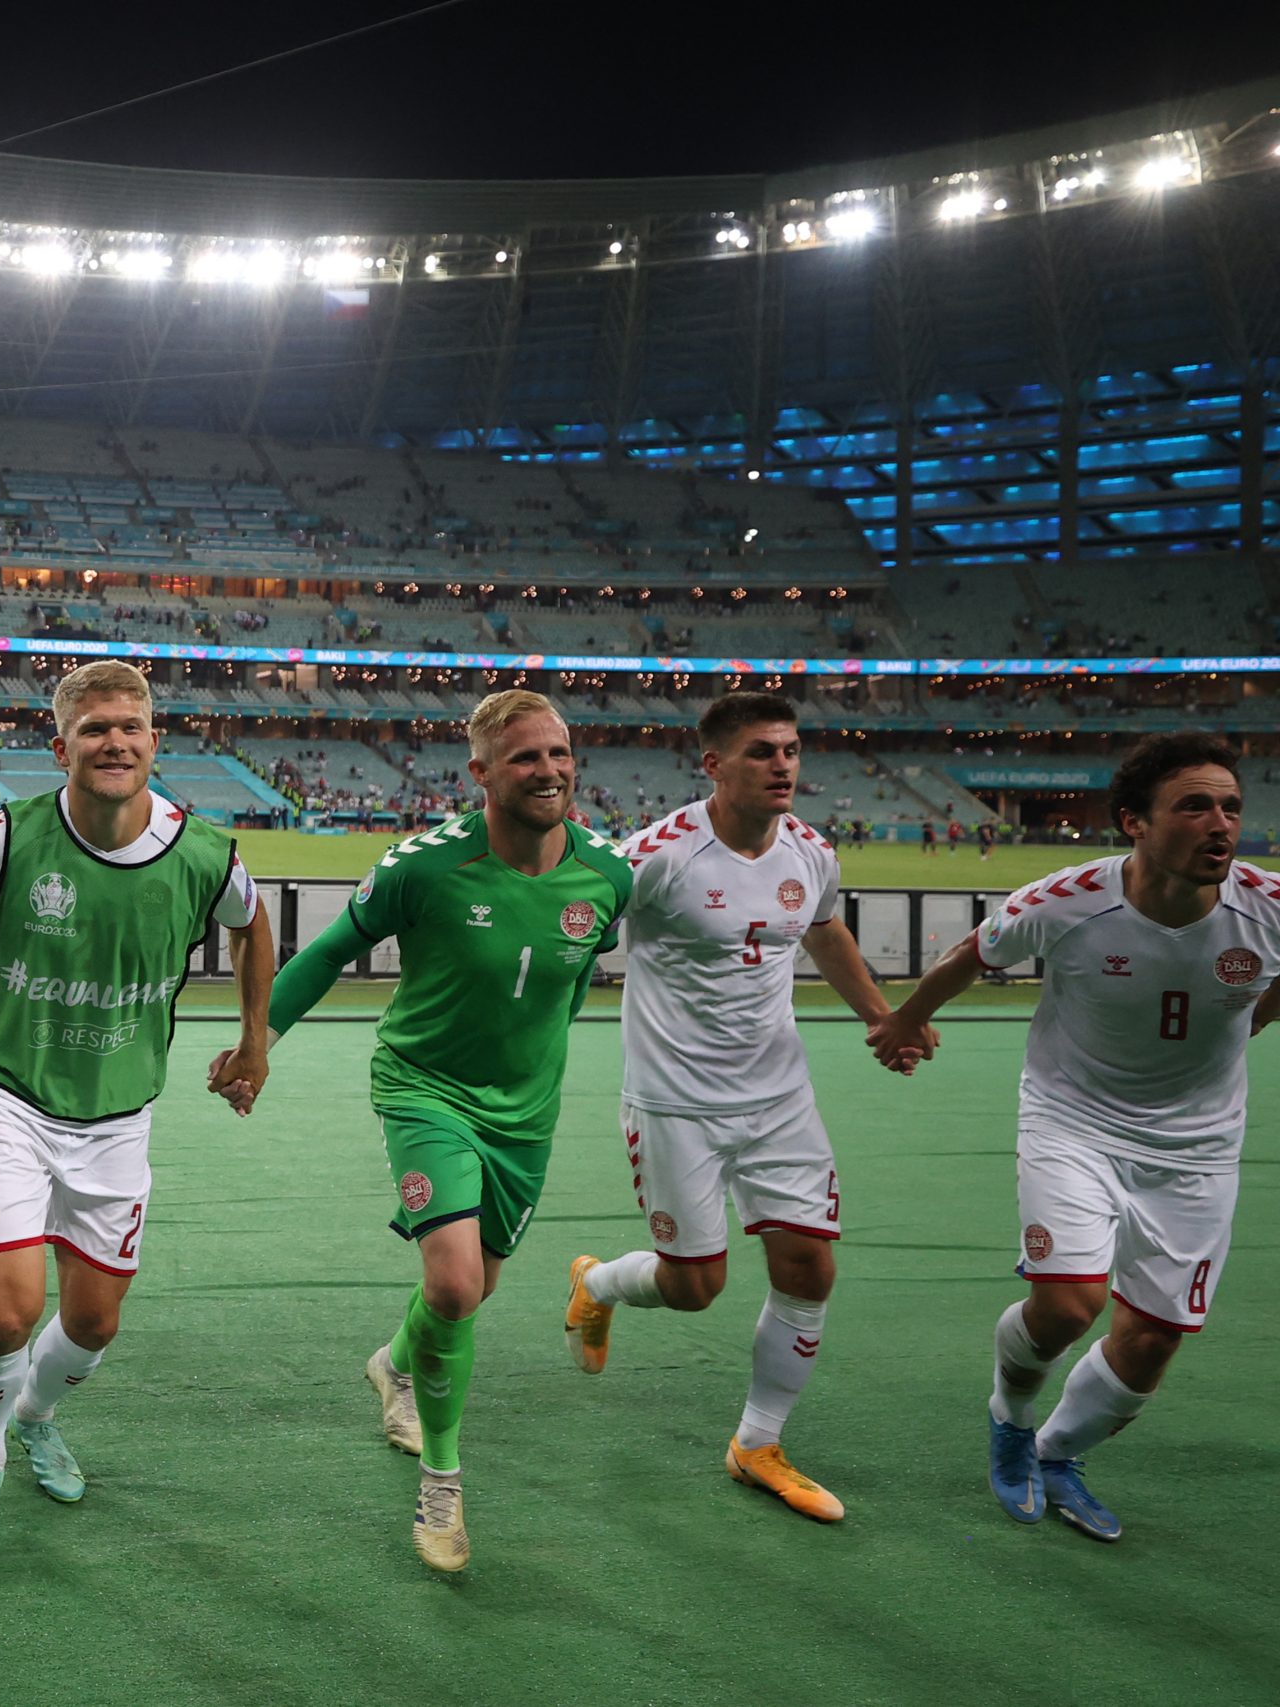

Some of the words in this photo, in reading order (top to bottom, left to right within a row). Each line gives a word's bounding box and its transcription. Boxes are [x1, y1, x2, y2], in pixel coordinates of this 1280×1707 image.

[26, 639, 54, 651] UEFA
[55, 640, 81, 652] EURO
[82, 641, 108, 654] 2020
[317, 650, 346, 662] BAKU
[558, 657, 585, 669] UEFA
[585, 657, 614, 669] EURO
[614, 658, 641, 670] 2020
[1182, 658, 1219, 671] UEFA
[1220, 658, 1259, 670] EURO
[877, 661, 911, 673] BAKU
[568, 912, 589, 924] DBU
[742, 921, 767, 965] 5
[513, 946, 532, 999] 1
[1223, 960, 1251, 972] DBU
[1160, 990, 1190, 1041] 8
[62, 1024, 140, 1049] RESPECT
[405, 1182, 424, 1199] DBU
[826, 1170, 840, 1222] 5
[118, 1203, 142, 1259] 2
[1188, 1259, 1211, 1314] 8
